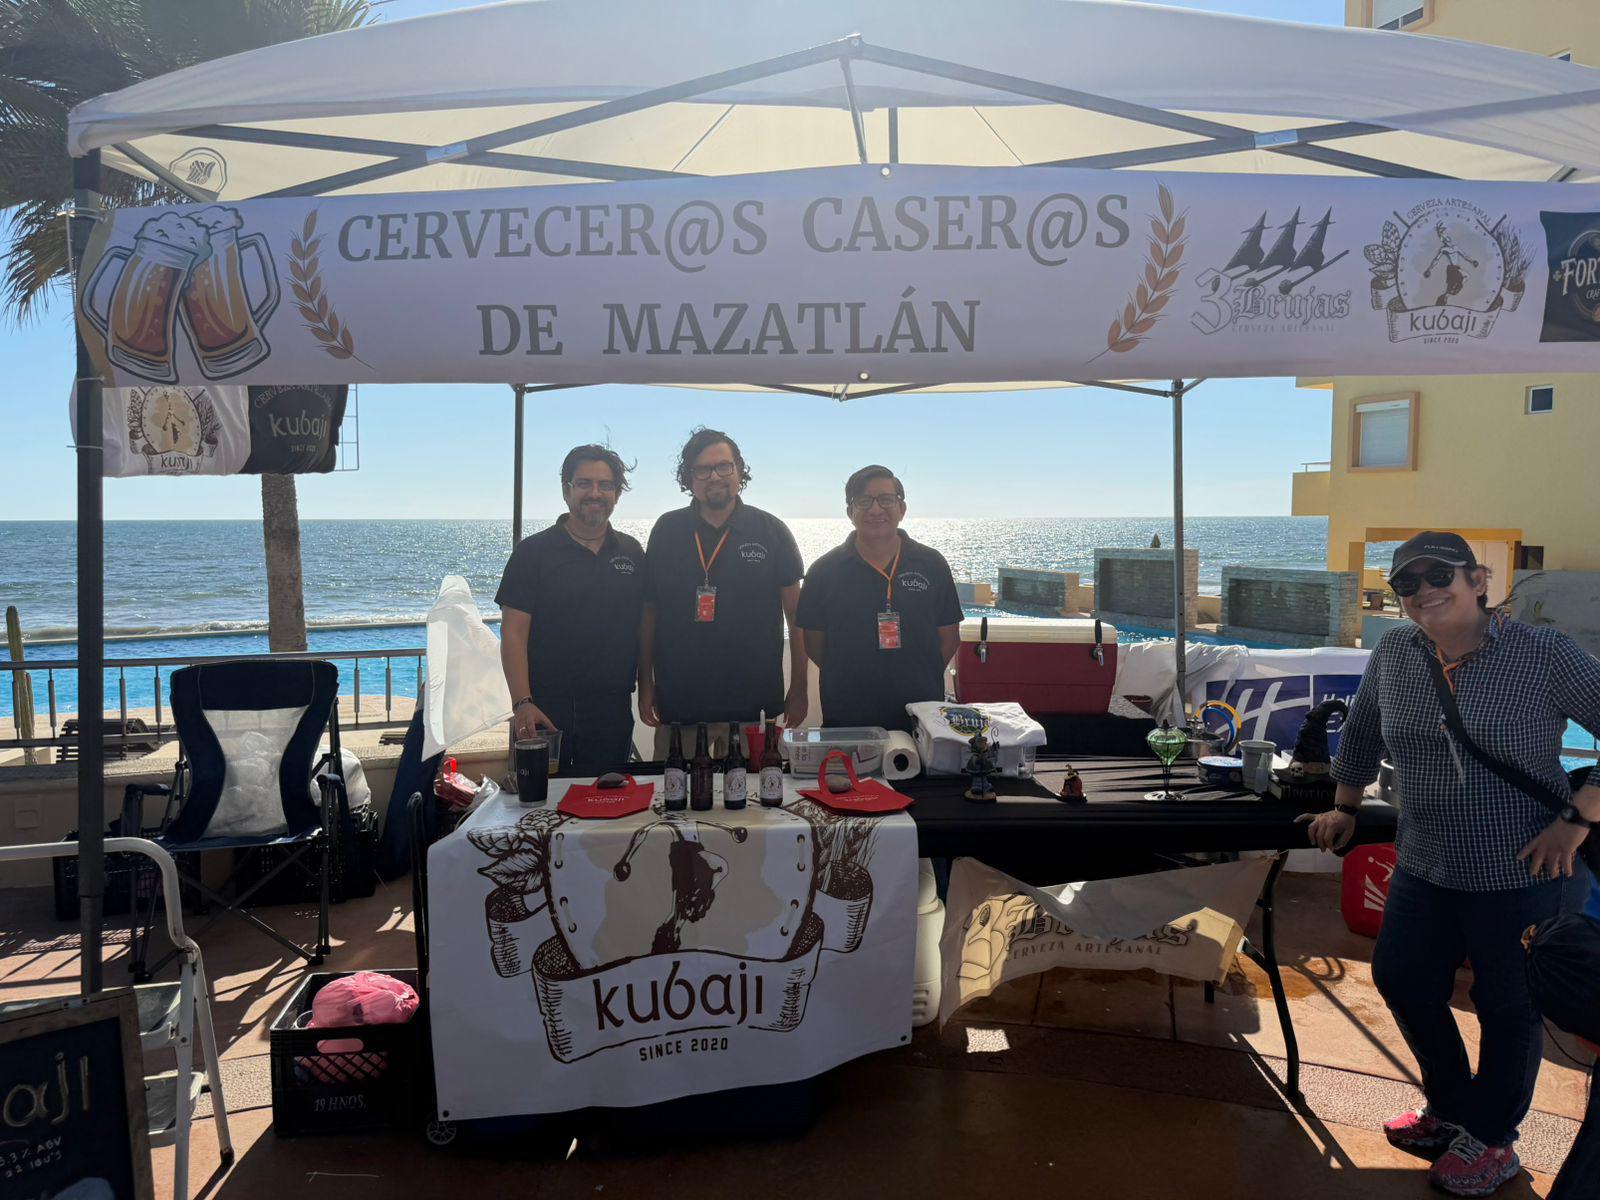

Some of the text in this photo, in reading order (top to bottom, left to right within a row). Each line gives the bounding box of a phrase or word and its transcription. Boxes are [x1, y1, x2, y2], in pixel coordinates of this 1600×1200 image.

[337, 192, 1131, 274] CERVECER@S CASER@S
[1560, 256, 1600, 297] FOR
[477, 285, 981, 357] DE MAZATLÁN
[1409, 308, 1478, 334] kubaji
[592, 959, 764, 1031] kubaji
[639, 1037, 729, 1062] SINCE 2020
